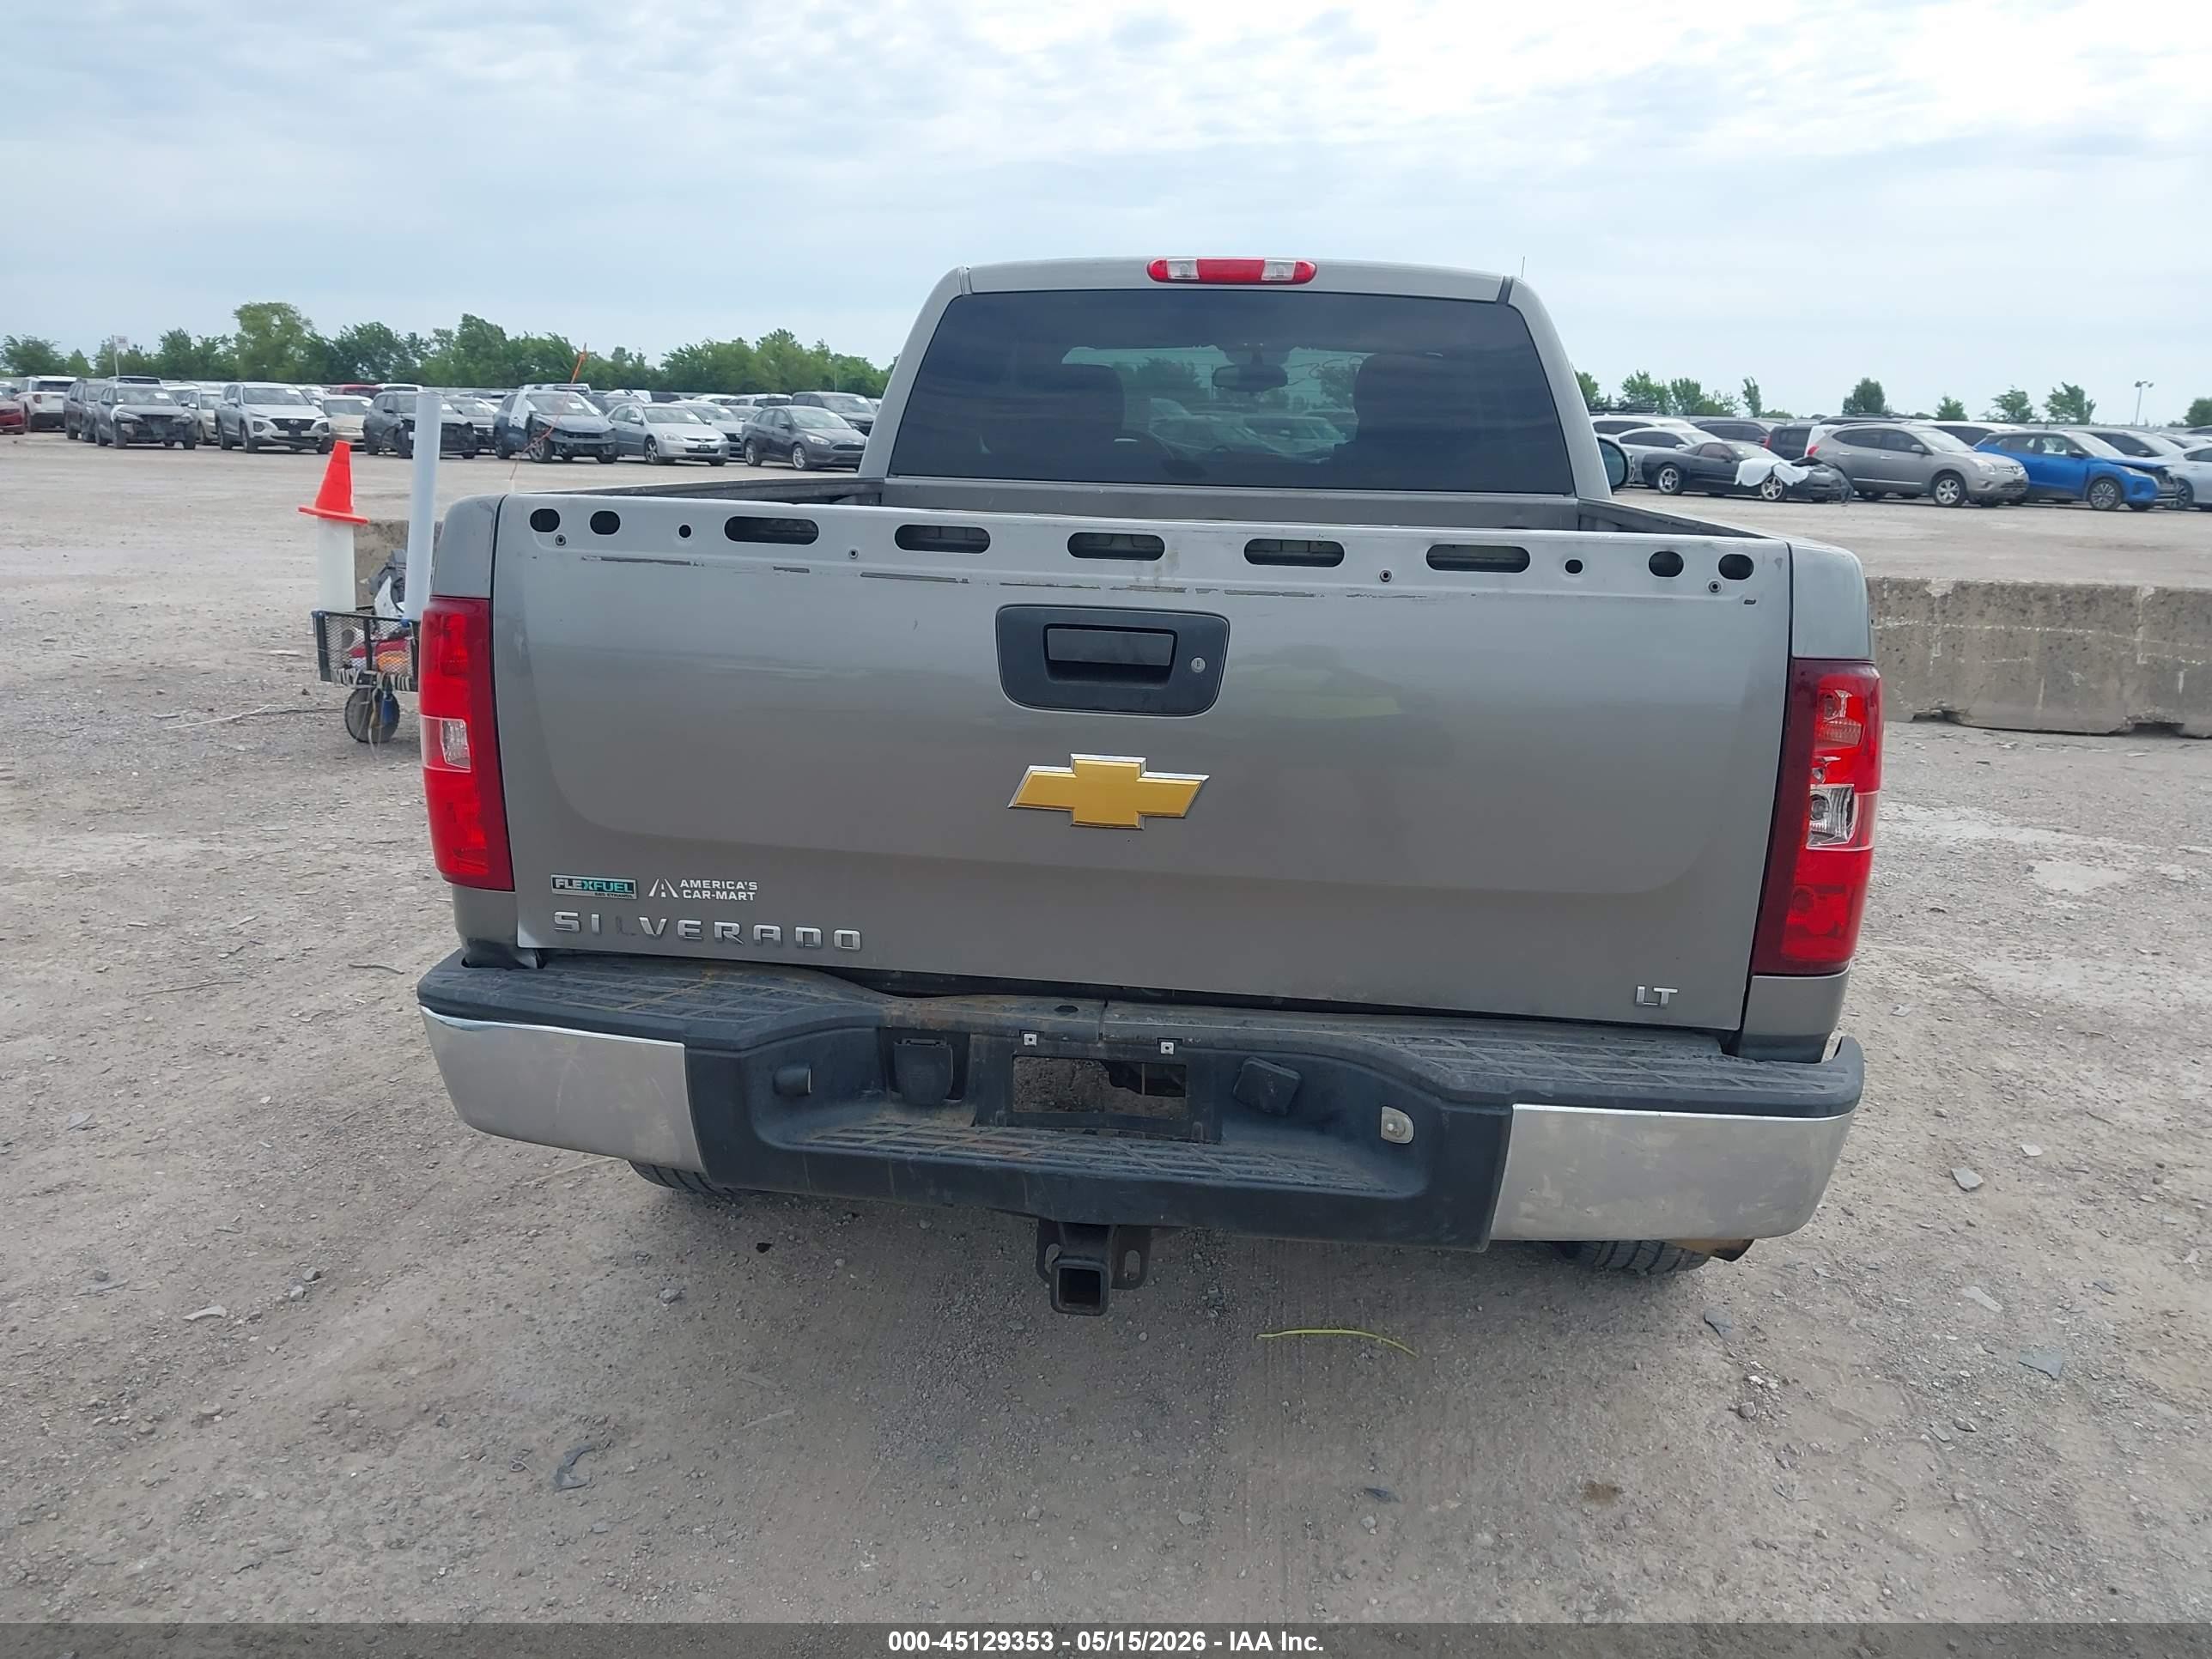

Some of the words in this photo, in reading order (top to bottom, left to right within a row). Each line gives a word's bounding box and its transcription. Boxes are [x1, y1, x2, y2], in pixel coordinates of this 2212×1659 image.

[556, 878, 633, 893] FLEXFUEL
[679, 879, 757, 890] AMERICA'S
[683, 889, 756, 901] CAR-MART
[1635, 985, 1679, 1005] LT
